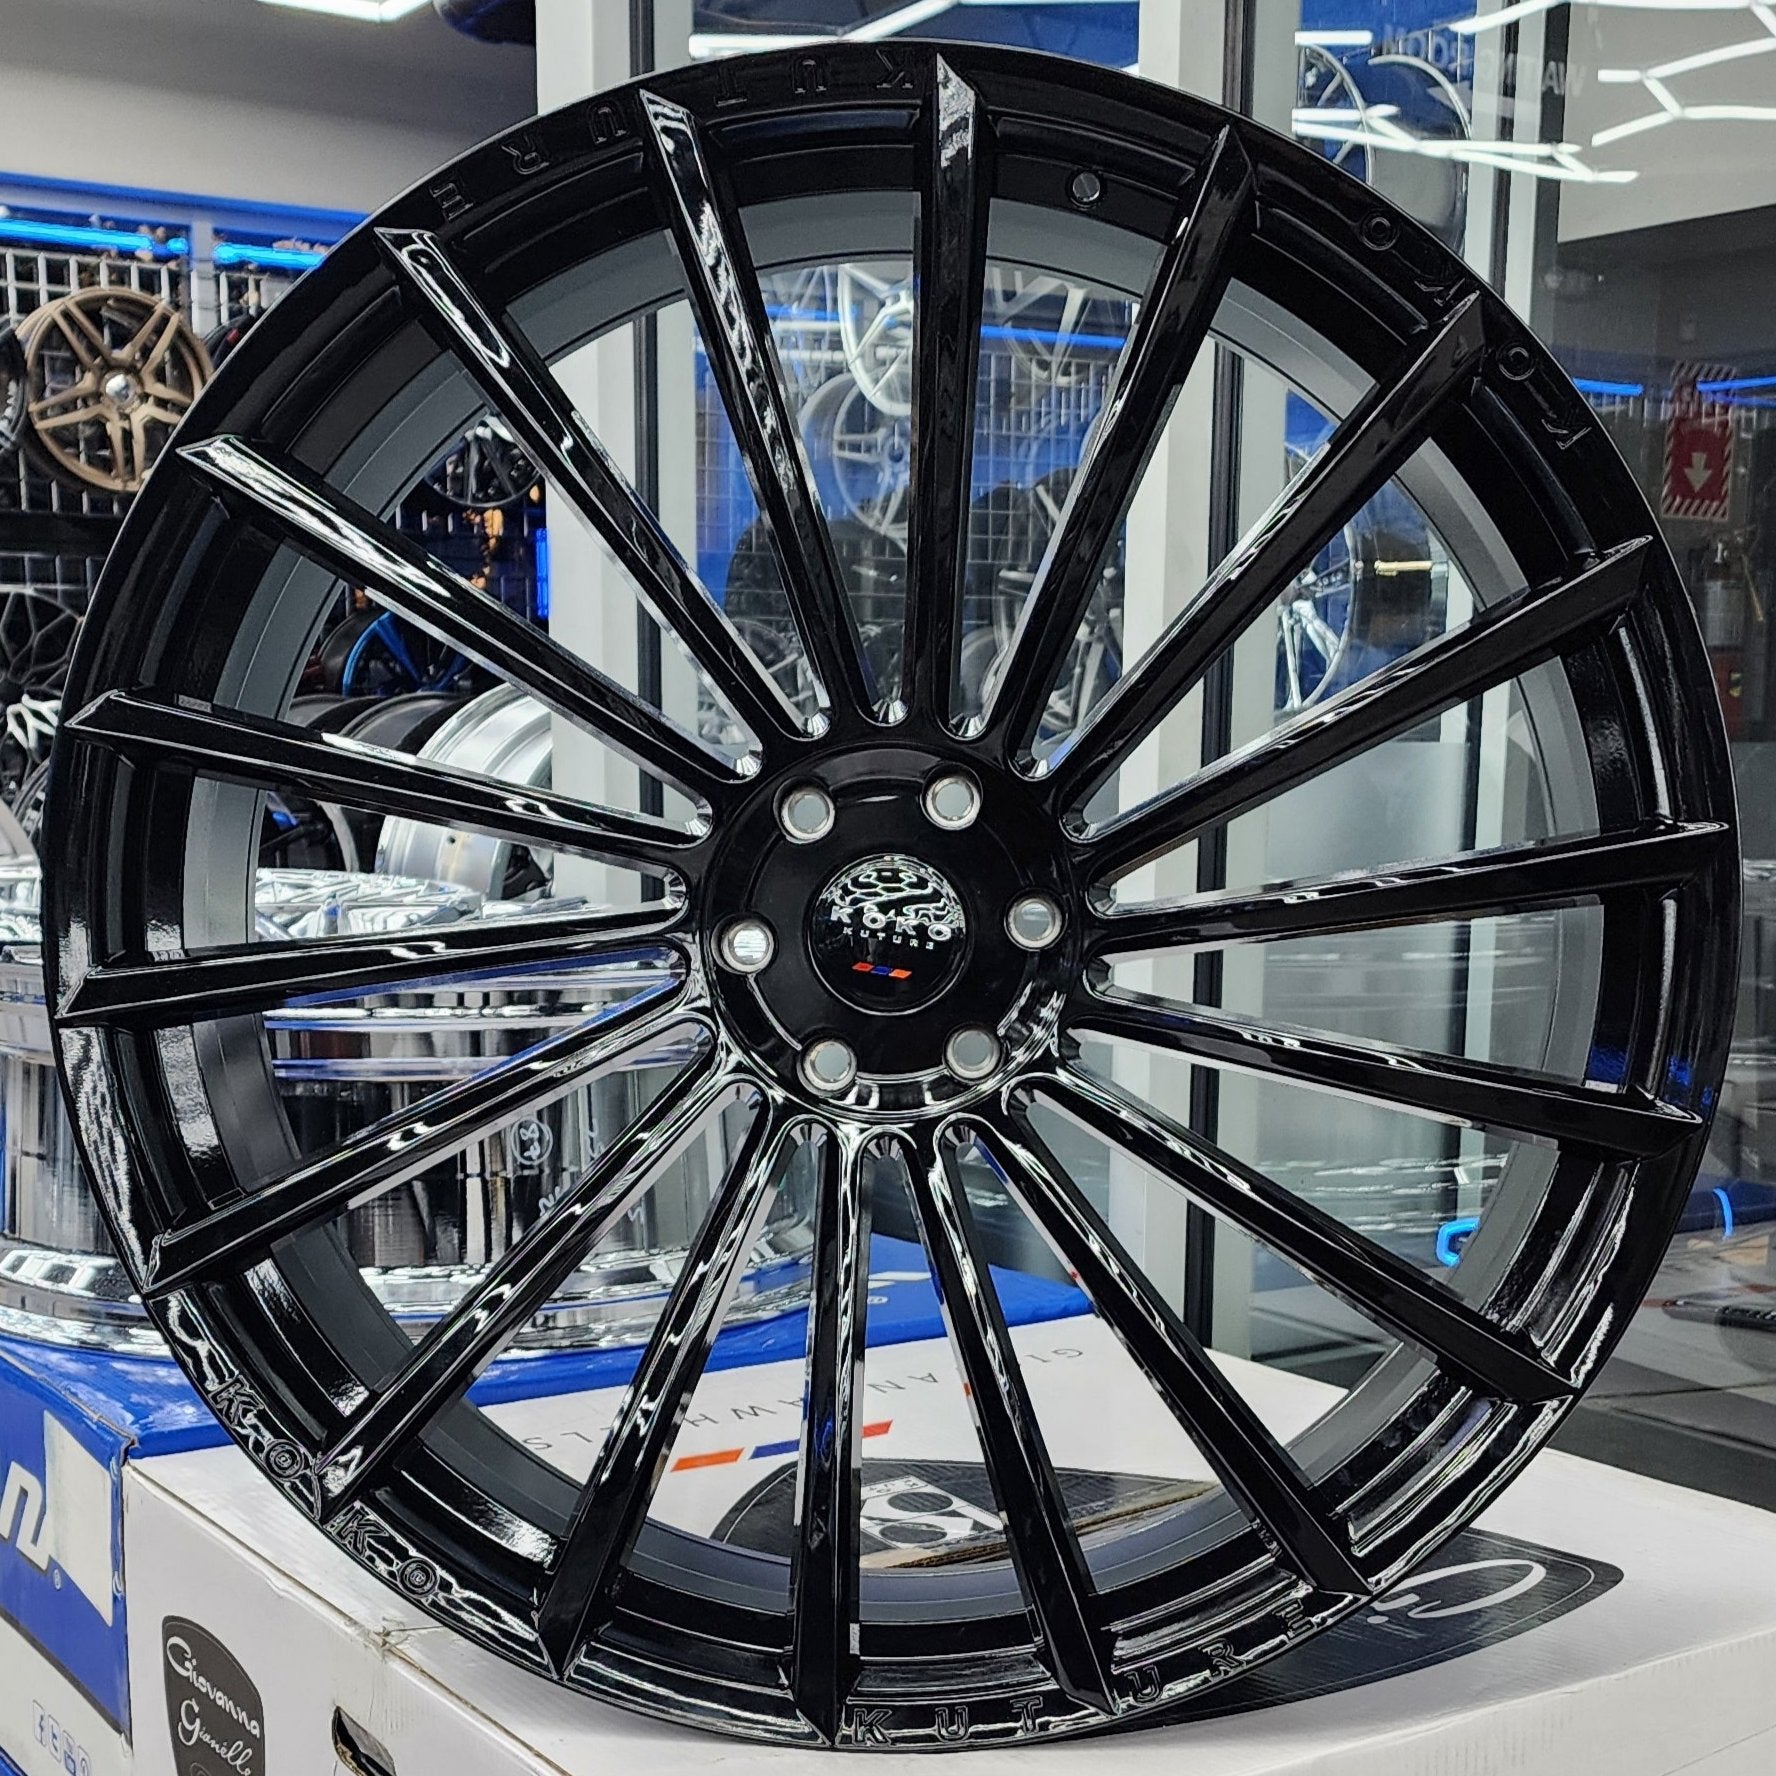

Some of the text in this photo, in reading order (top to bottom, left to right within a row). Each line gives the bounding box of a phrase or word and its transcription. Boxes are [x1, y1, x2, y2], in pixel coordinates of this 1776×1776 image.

[428, 48, 916, 222] KUTURE
[830, 905, 952, 942] KOKO
[842, 926, 935, 950] KUTURE
[522, 1403, 778, 1451] WHLS
[166, 1635, 261, 1739] Giovanna
[851, 1598, 1317, 1747] KUTURE
